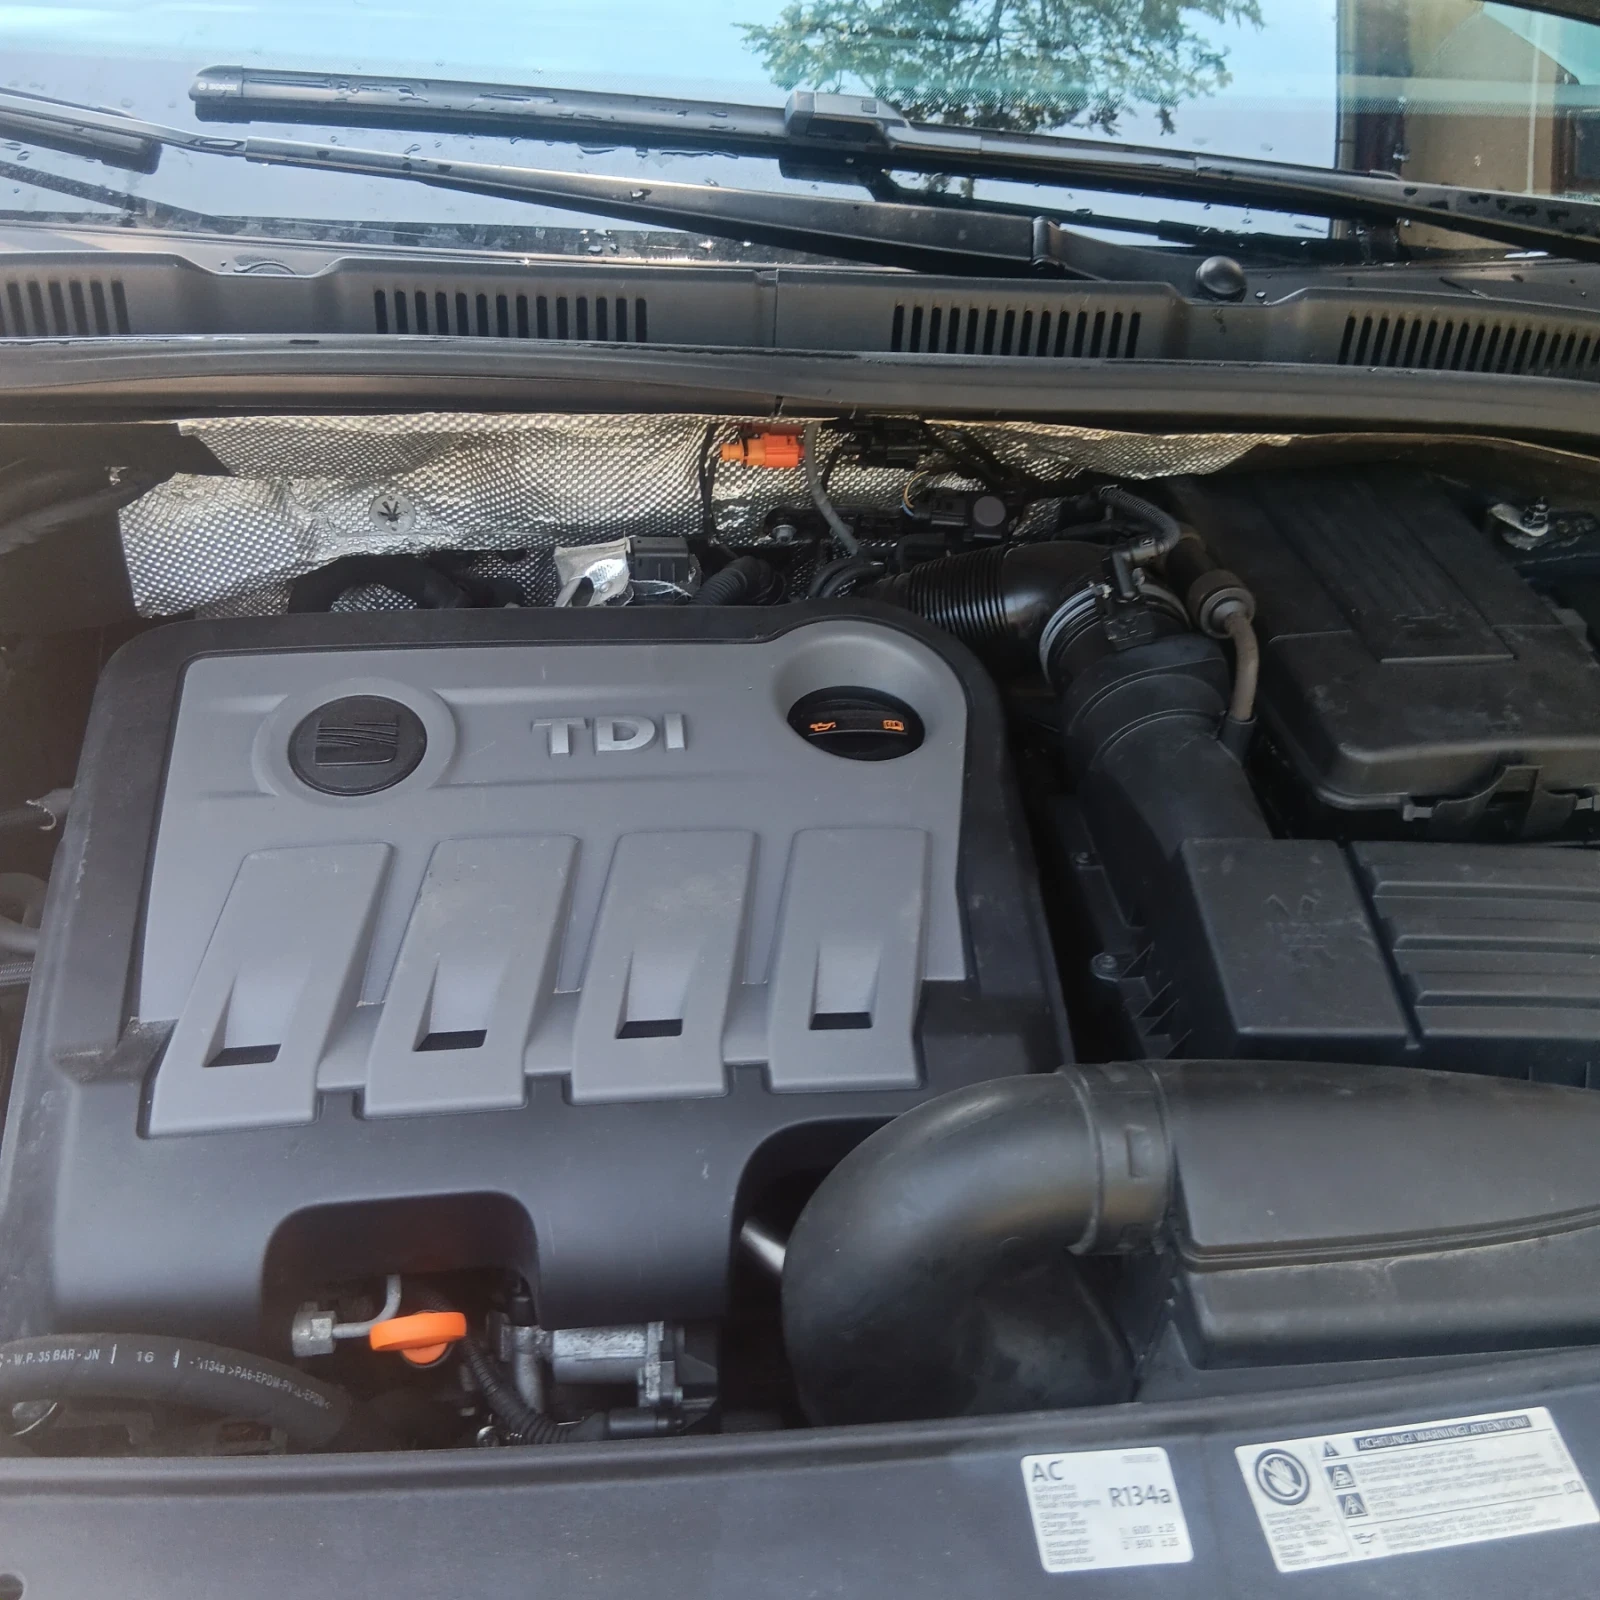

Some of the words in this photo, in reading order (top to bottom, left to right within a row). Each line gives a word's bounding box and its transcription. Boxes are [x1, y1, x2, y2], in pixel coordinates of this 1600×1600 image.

[531, 713, 688, 757] TDI
[53, 1348, 76, 1361] BAR
[136, 1351, 154, 1363] 16
[1032, 1460, 1064, 1482] AC
[1108, 1485, 1173, 1507] R134a
